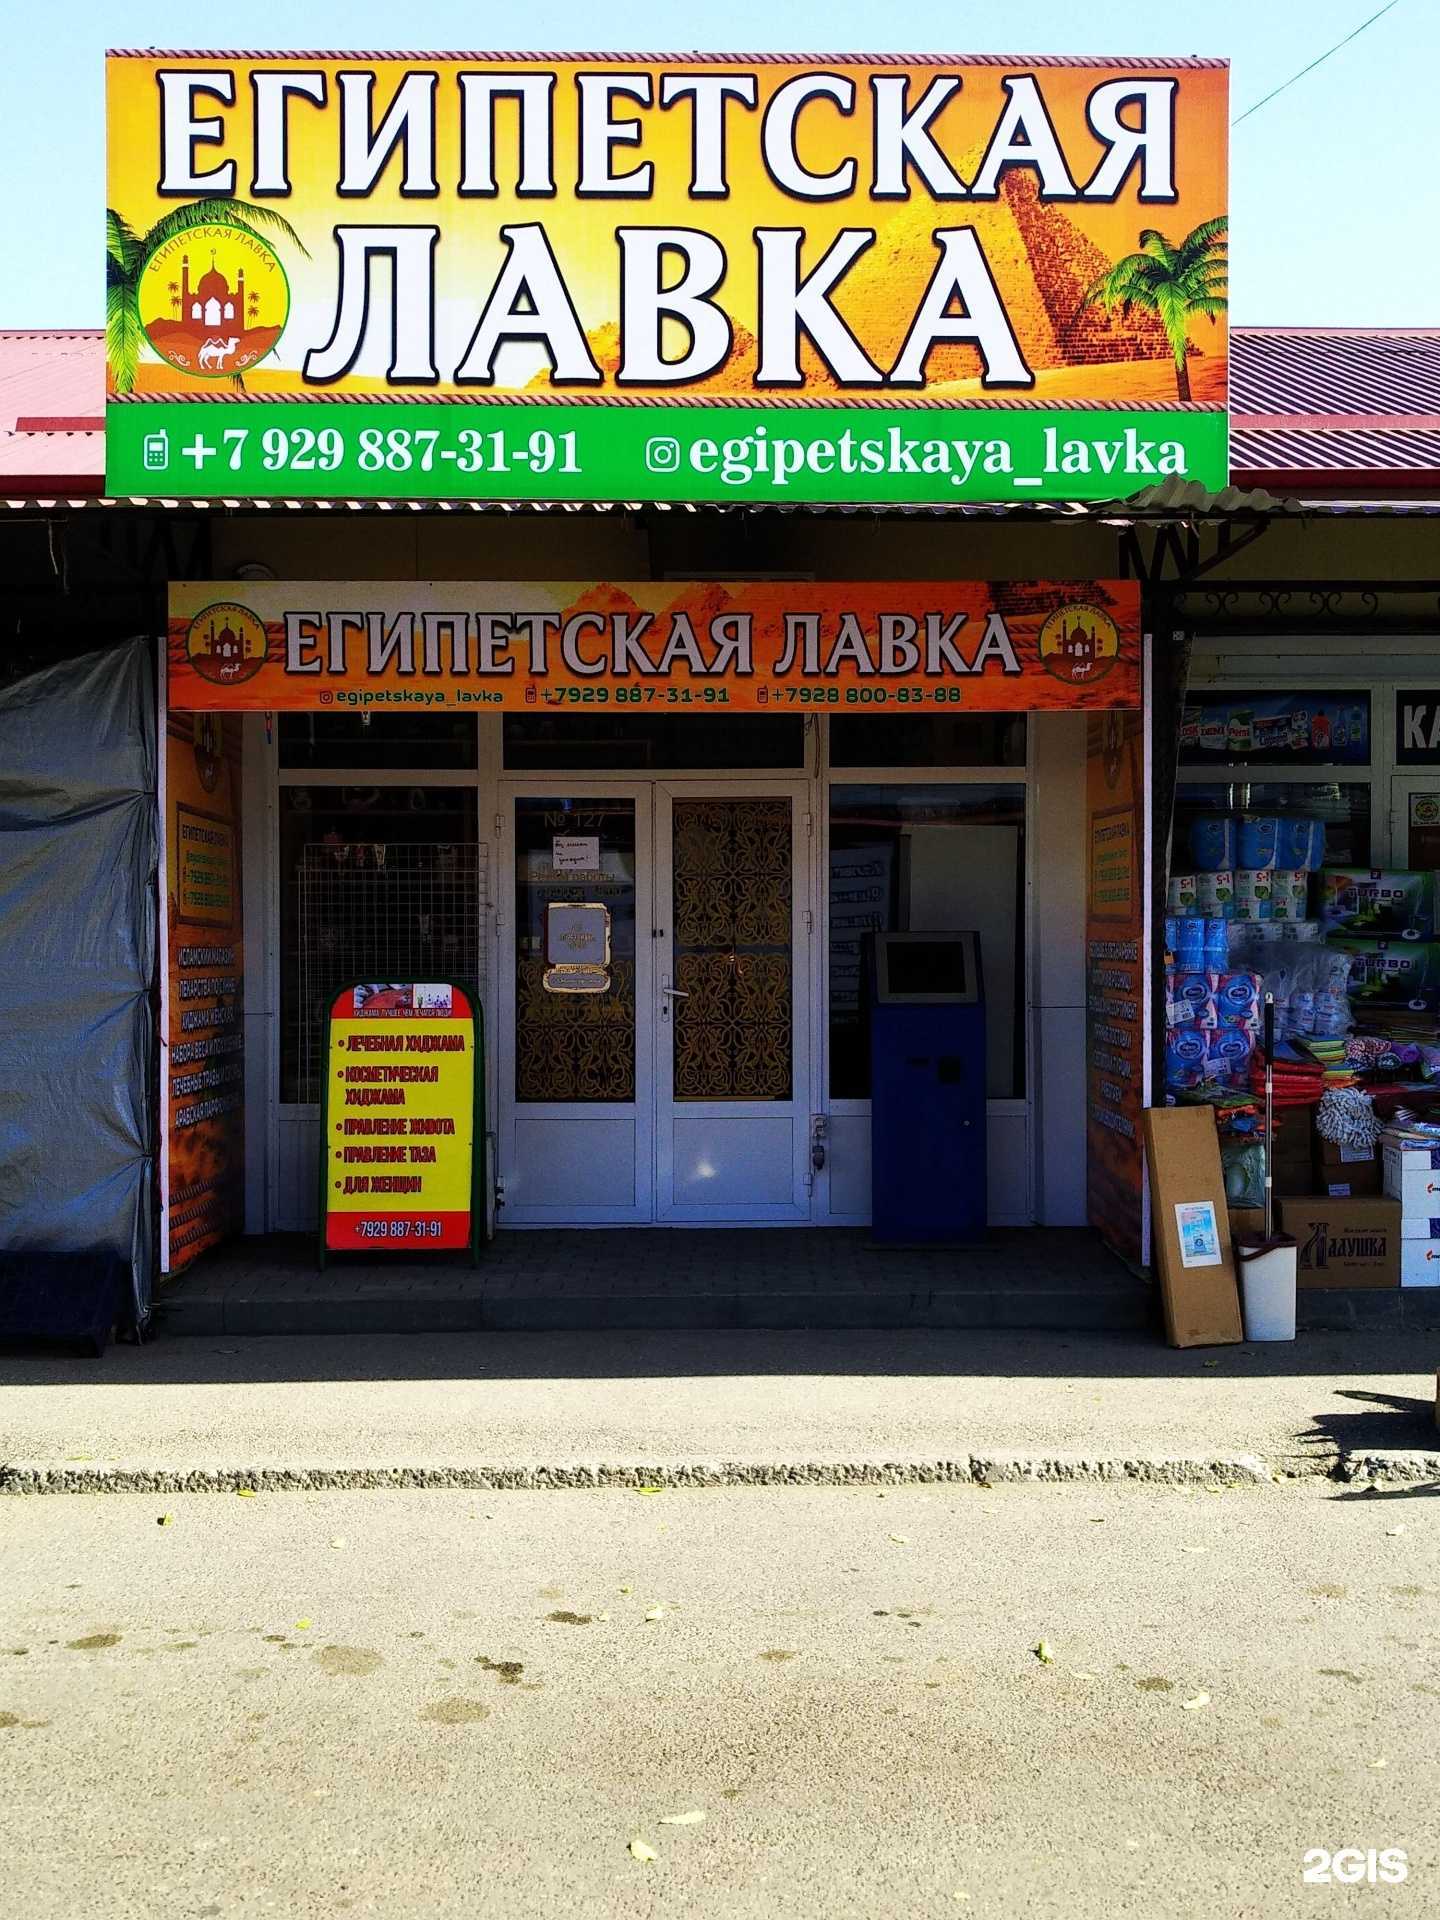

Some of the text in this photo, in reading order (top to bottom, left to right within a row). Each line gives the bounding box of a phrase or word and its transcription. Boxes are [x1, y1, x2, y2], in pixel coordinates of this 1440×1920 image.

[156, 70, 1178, 203] ЕГИПЕТСКАЯ
[148, 226, 277, 273] ЕГИПЕТСКАЯ ЛАВКА
[302, 221, 1035, 389] ЛАВКА
[181, 428, 583, 473] +7 929 887-31-91
[689, 426, 1188, 486] egipetskaya_lavka
[283, 611, 1023, 678] ЕГИПЕТСКАЯ ЛАВКА
[336, 689, 504, 707] egipetskaya_lavka
[540, 687, 730, 704] +7929 887-31-91
[771, 687, 961, 704] +7928 800-83-88
[1348, 888, 1404, 898] TURBO
[1355, 958, 1410, 969] TURBO
[347, 1035, 465, 1053] ЛЕЧЕБНАЯ ХИДЖАМА
[345, 1065, 439, 1082] КОСМЕТИЧЕСКАЯ
[345, 1088, 405, 1106] ХИДЖАМА
[344, 1118, 455, 1135] ПРАВЛЕНИЕ ЖИВОТА
[344, 1146, 436, 1163] ПРАВЛЕНИЕ ТАЗА
[343, 1176, 422, 1194] ДЛЯ ЖЕНЩИН
[354, 1221, 442, 1237] +7929 887-31-91
